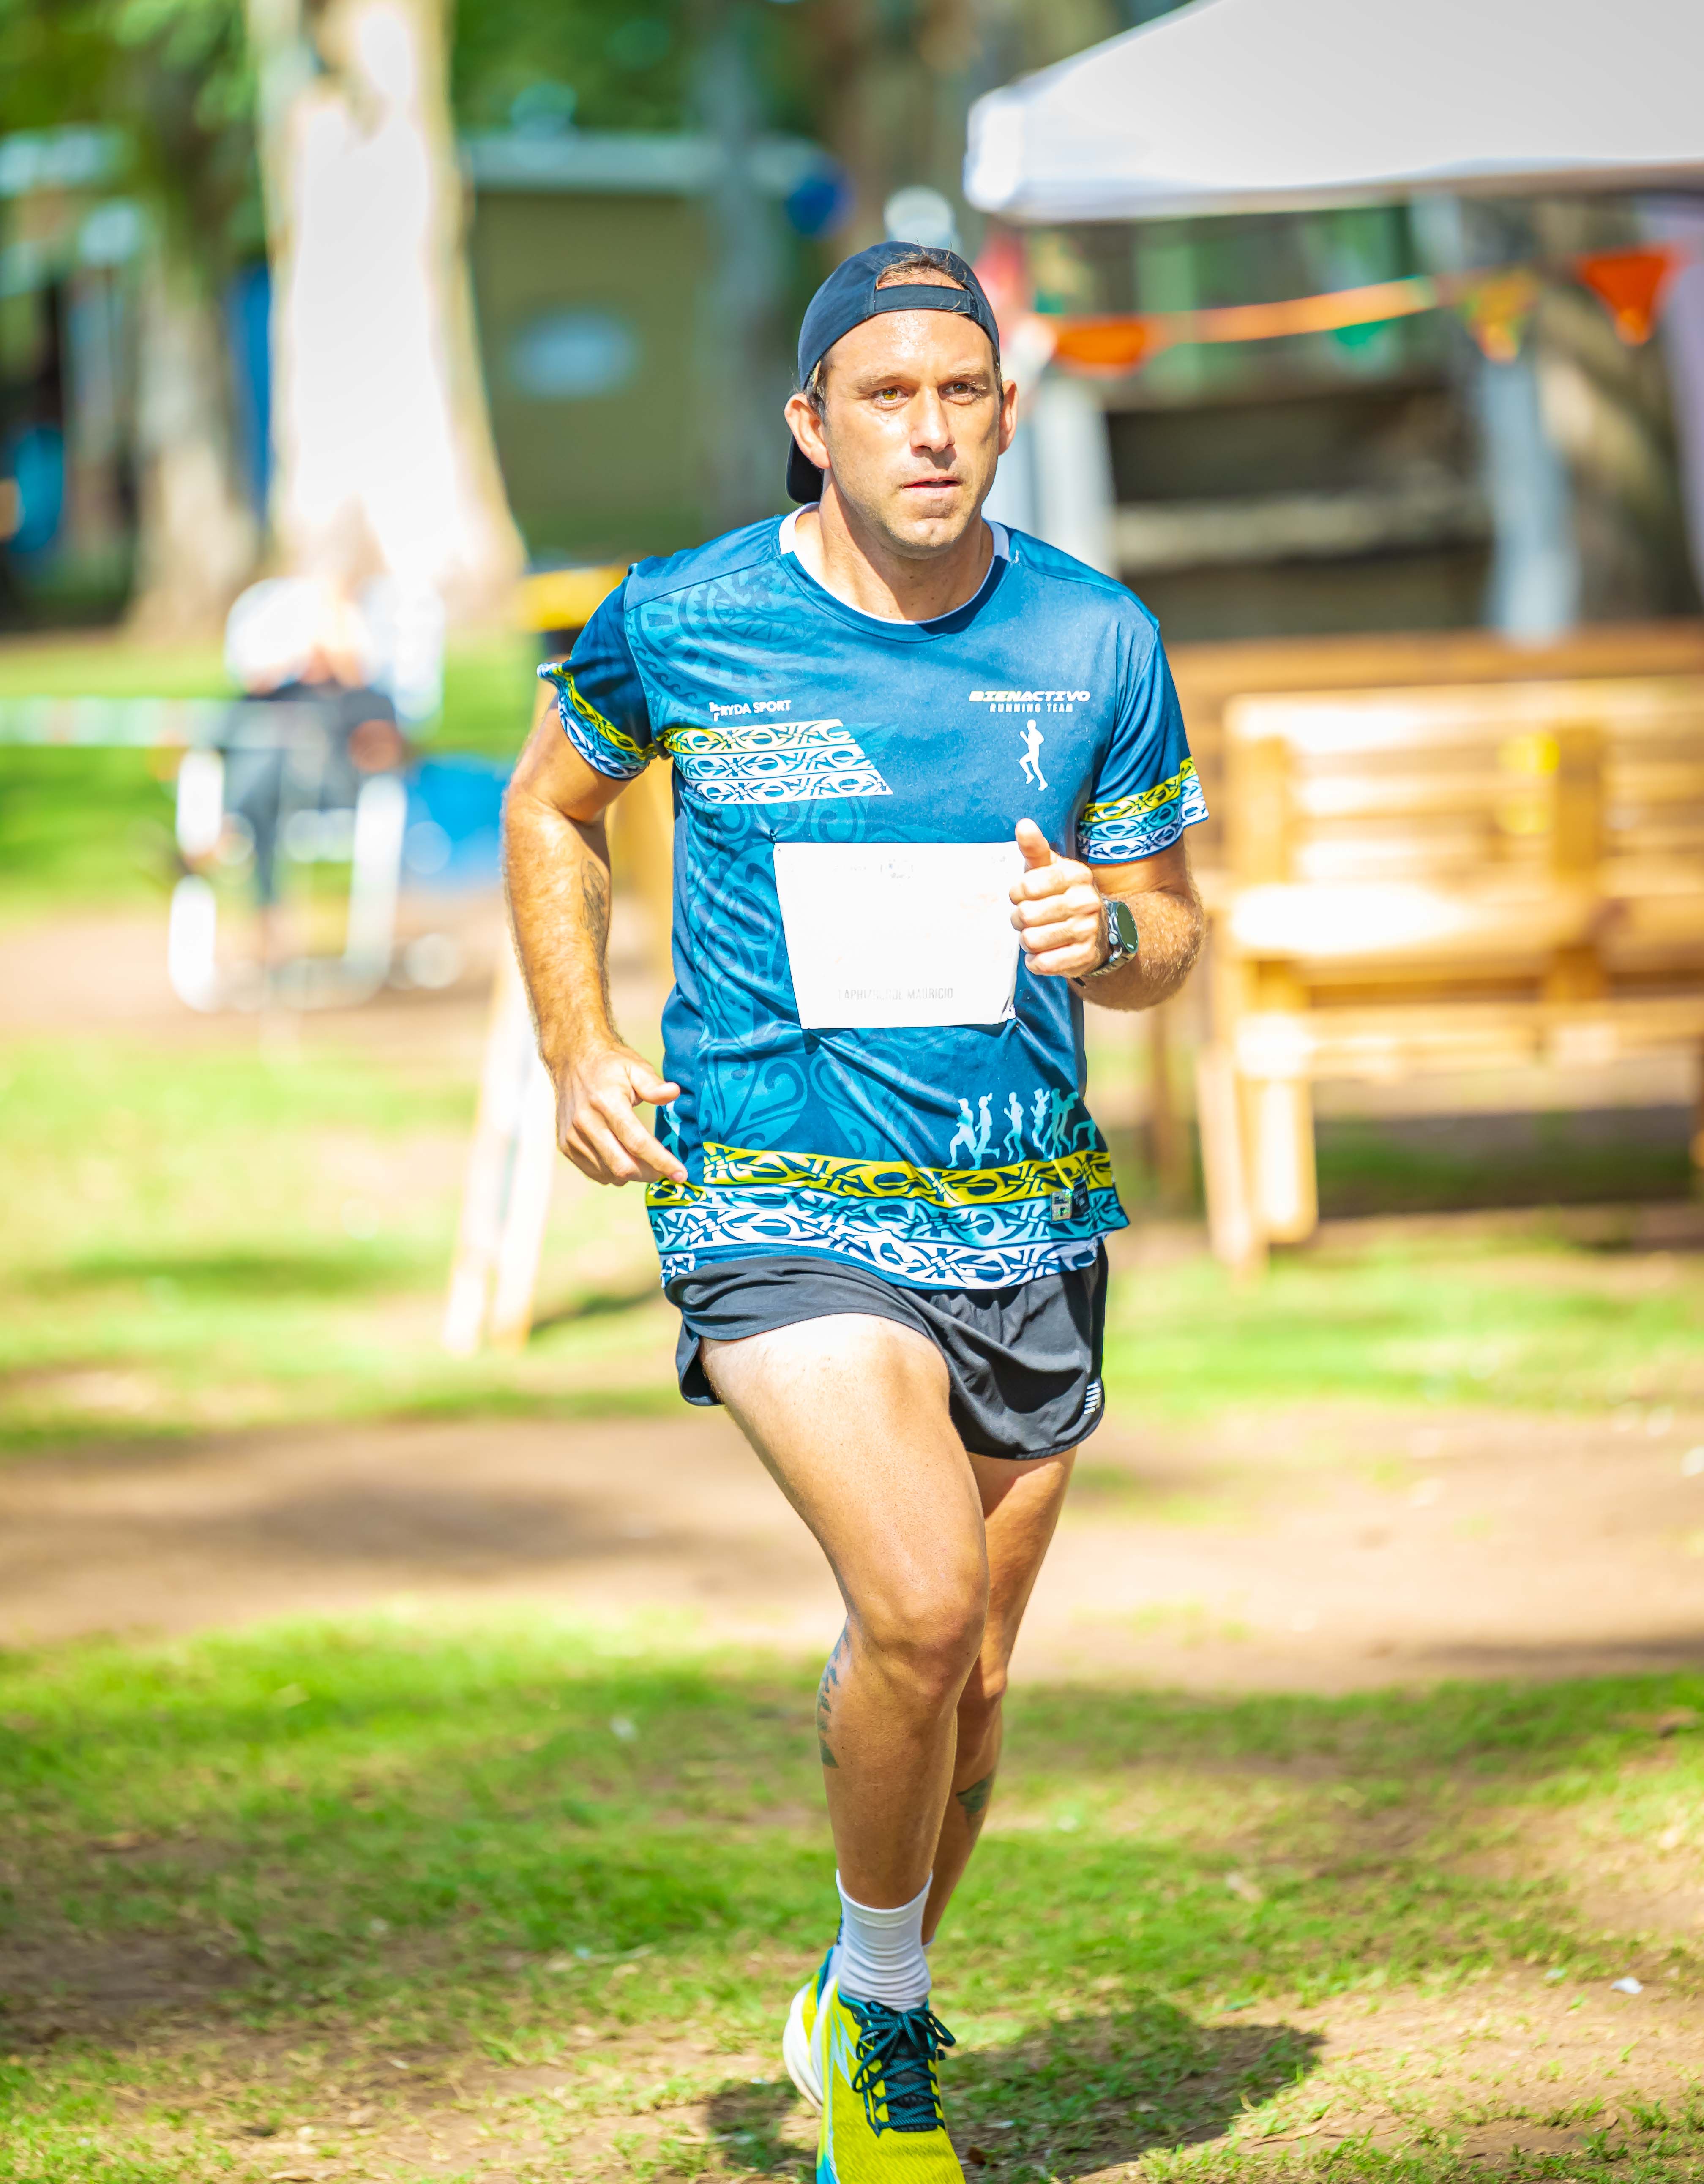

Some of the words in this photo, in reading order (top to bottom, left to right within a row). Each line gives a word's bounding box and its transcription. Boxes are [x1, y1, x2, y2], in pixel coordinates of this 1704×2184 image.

[969, 690, 1090, 702] BIENACTIVO
[753, 700, 792, 713] SPORT
[990, 703, 1041, 713] RUNNING
[1047, 703, 1073, 713] TEAM
[907, 987, 953, 1000] MAURICIO
